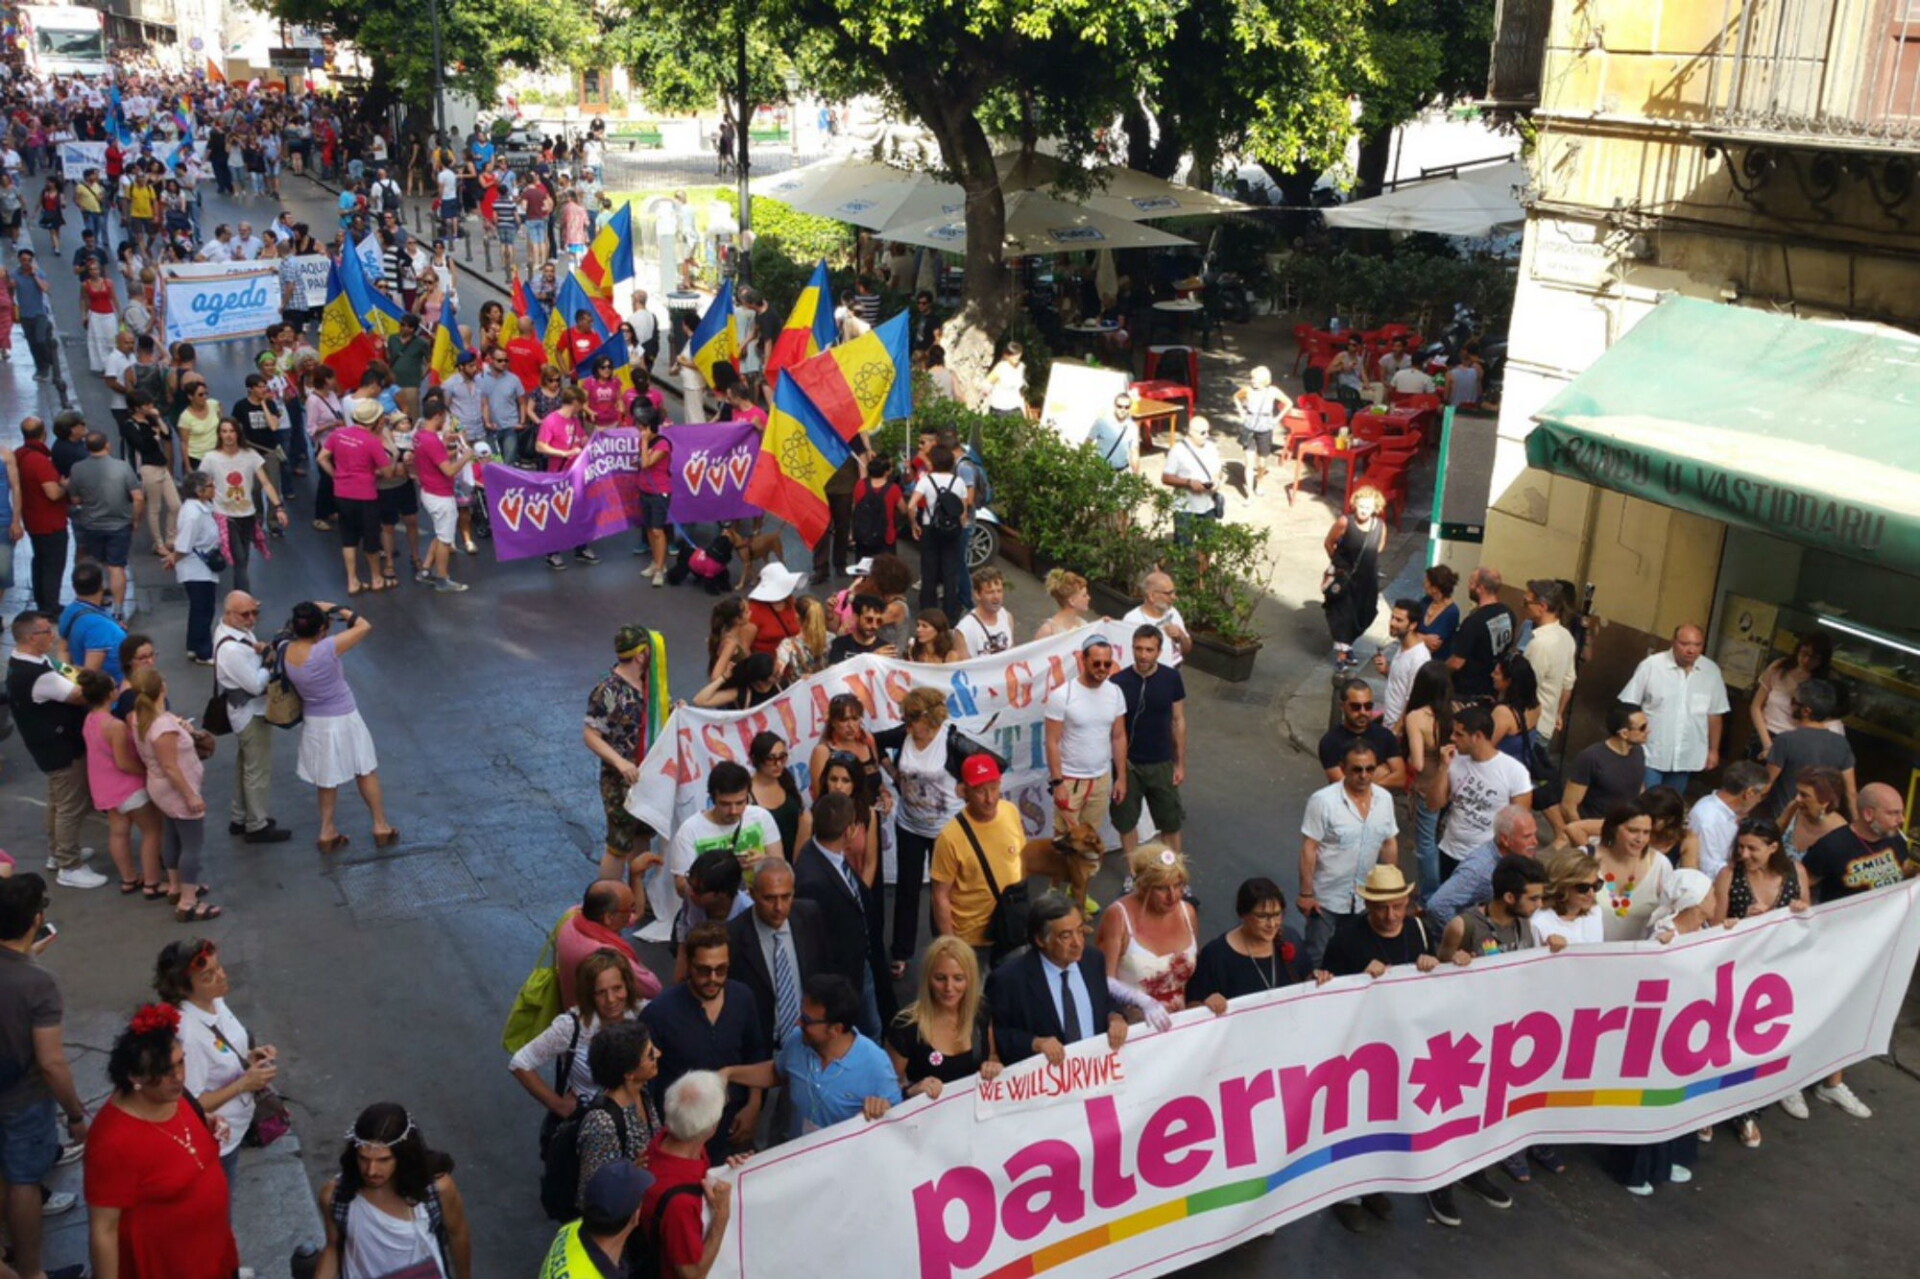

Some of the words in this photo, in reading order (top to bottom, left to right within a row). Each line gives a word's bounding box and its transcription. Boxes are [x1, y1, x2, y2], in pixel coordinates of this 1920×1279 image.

[191, 278, 267, 326] agedo
[588, 436, 640, 461] FAMIGLI
[1664, 461, 1683, 495] U
[1696, 466, 1887, 550] VASTIDDARU
[979, 1080, 1003, 1102] WE
[1006, 1067, 1048, 1101] WILL
[1046, 1051, 1125, 1097] SURVIVE
